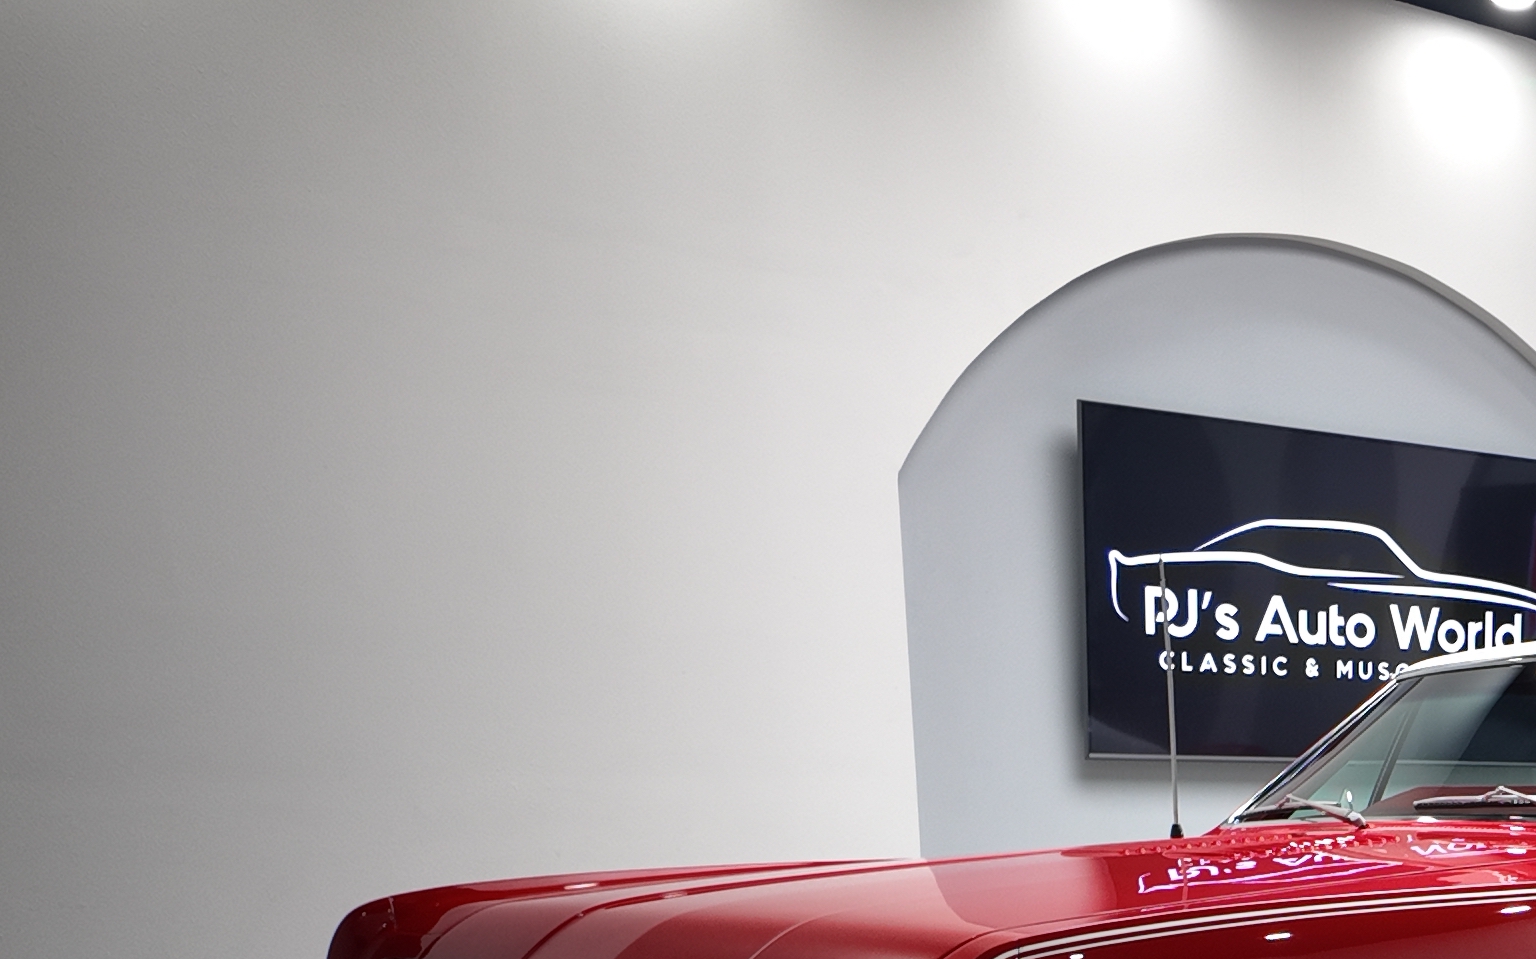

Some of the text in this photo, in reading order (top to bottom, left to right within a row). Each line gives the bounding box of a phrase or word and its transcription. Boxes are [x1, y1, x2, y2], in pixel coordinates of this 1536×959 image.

[1144, 585, 1523, 653] PJ's Auto World
[1158, 650, 1289, 677] CLASSIC
[1305, 657, 1319, 678] &
